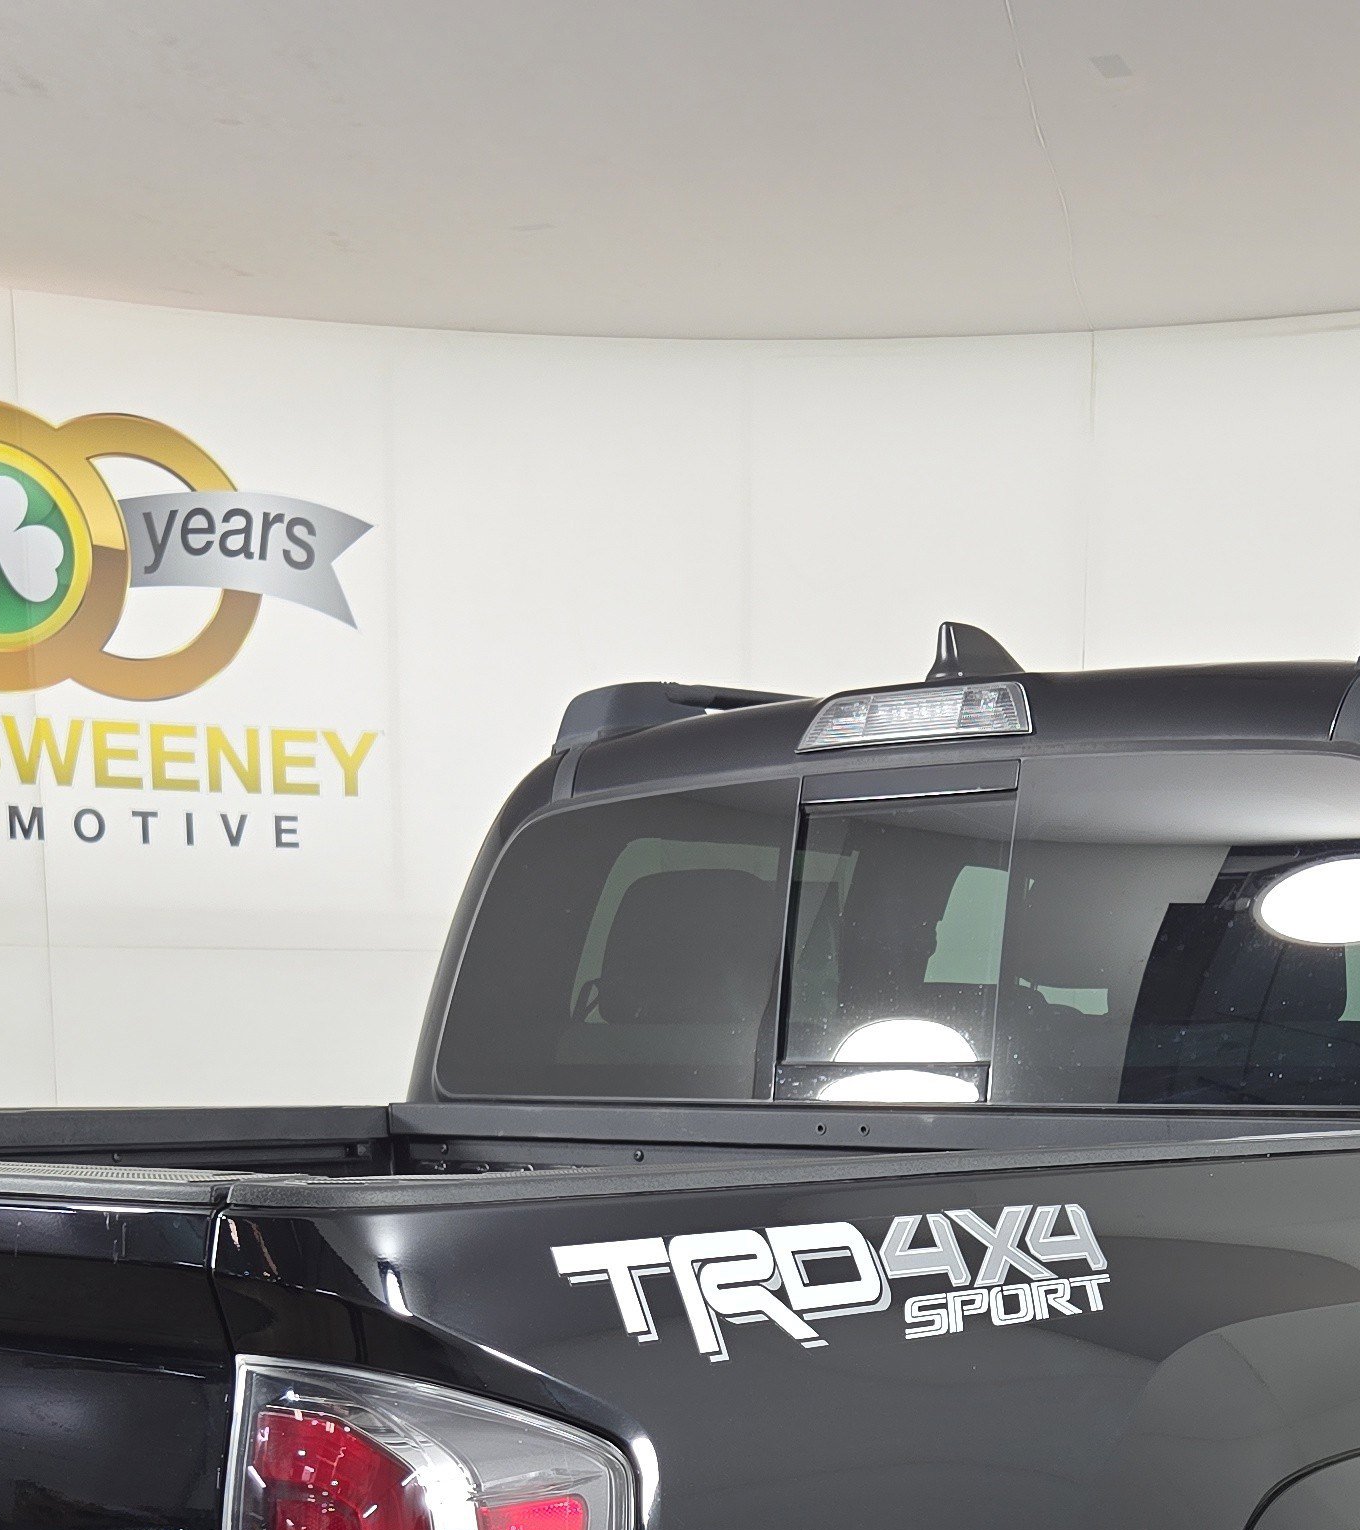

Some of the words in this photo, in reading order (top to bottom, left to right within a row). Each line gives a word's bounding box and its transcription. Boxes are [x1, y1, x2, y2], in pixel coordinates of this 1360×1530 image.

[142, 505, 317, 575] years
[550, 1221, 892, 1363] TRD
[904, 1273, 1112, 1341] SPORT
